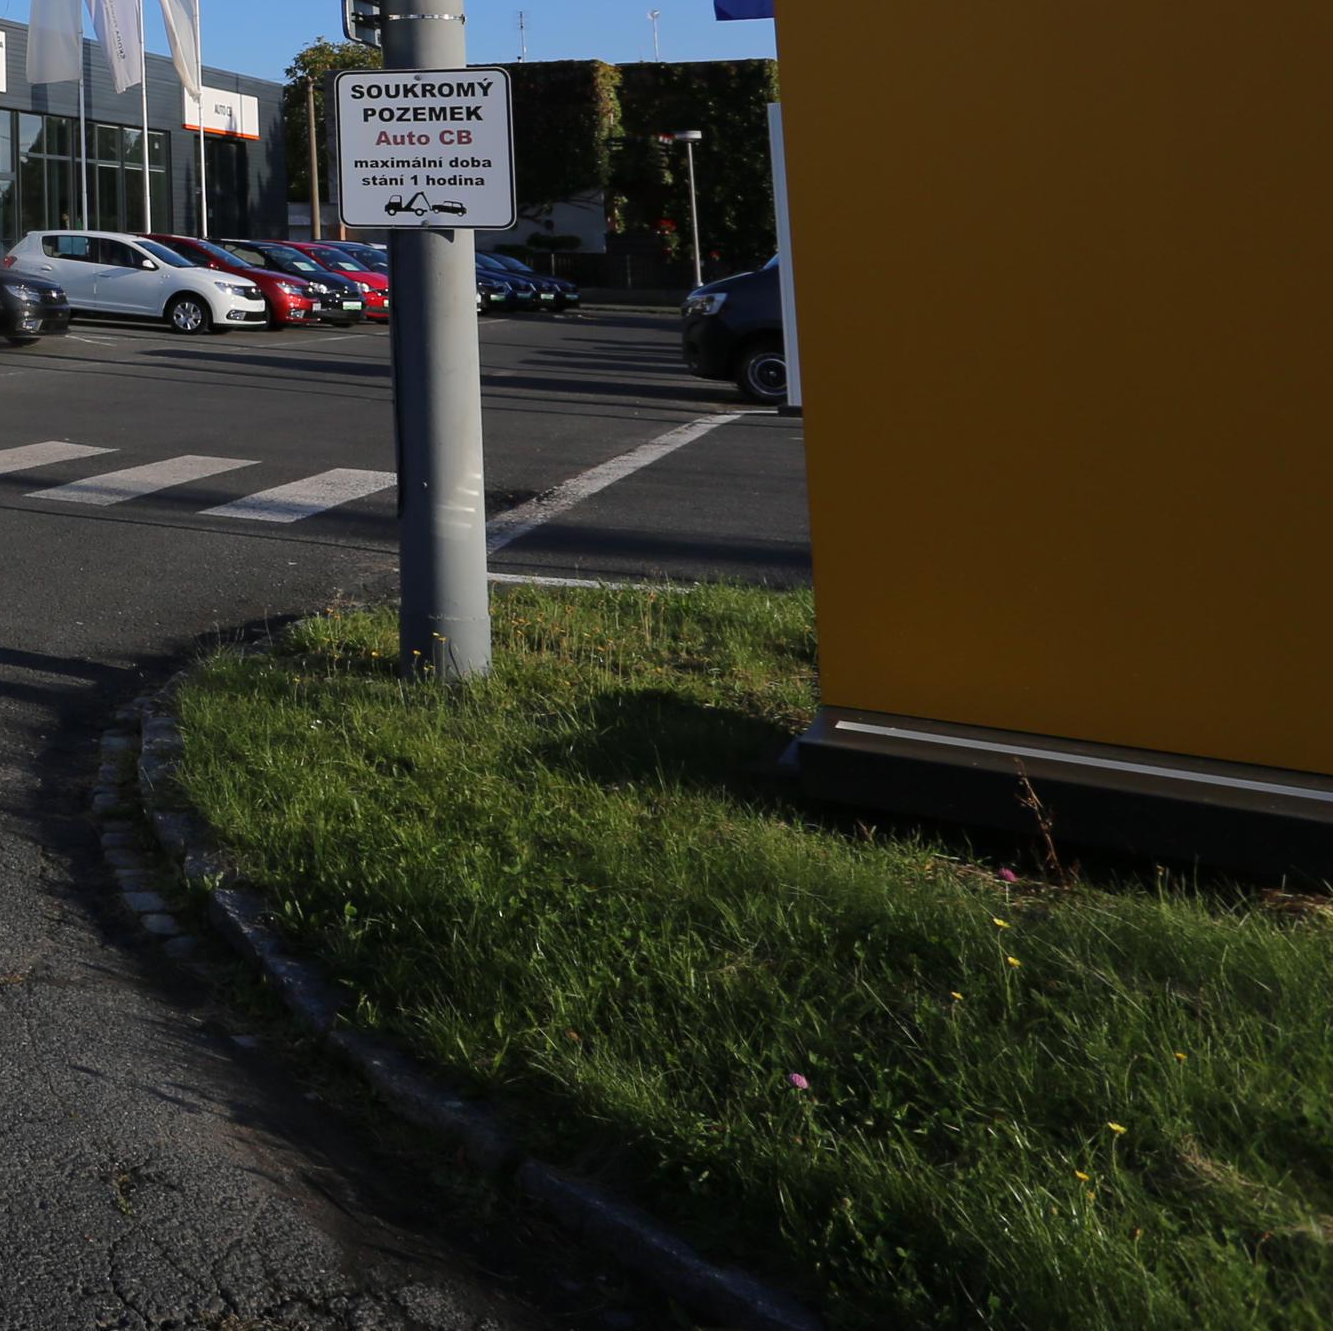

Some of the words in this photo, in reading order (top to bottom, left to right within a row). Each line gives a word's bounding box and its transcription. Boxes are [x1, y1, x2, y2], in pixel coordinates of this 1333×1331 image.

[350, 78, 494, 100] SOUKROMÝ
[363, 106, 484, 123] POZEMEK
[375, 130, 431, 146] Auto
[439, 129, 473, 146] CB
[354, 156, 443, 169] maximální
[449, 156, 493, 168] doba
[361, 174, 404, 186] stání
[410, 175, 419, 186] 1
[426, 174, 485, 186] hodina
